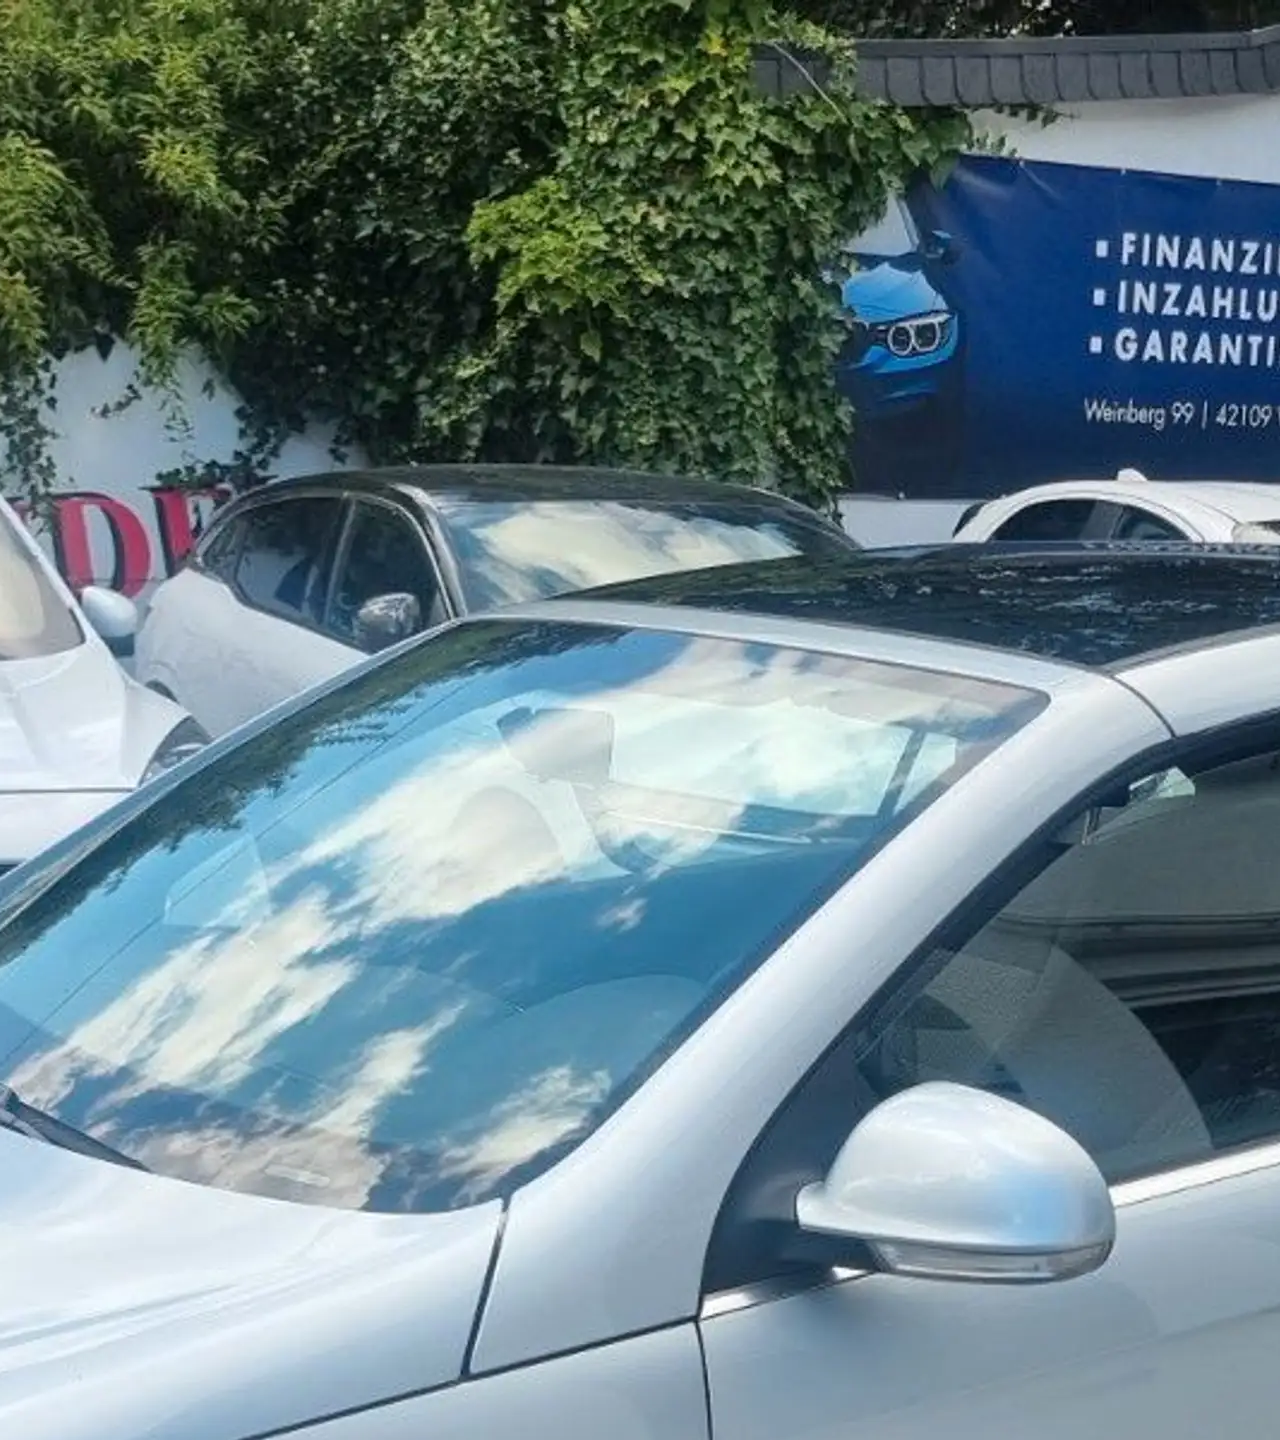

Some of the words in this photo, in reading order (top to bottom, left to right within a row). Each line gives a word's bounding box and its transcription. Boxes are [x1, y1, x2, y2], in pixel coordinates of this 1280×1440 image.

[1083, 398, 1166, 431] Weinberg
[1171, 401, 1195, 426] 99
[1215, 403, 1273, 428] 42109
